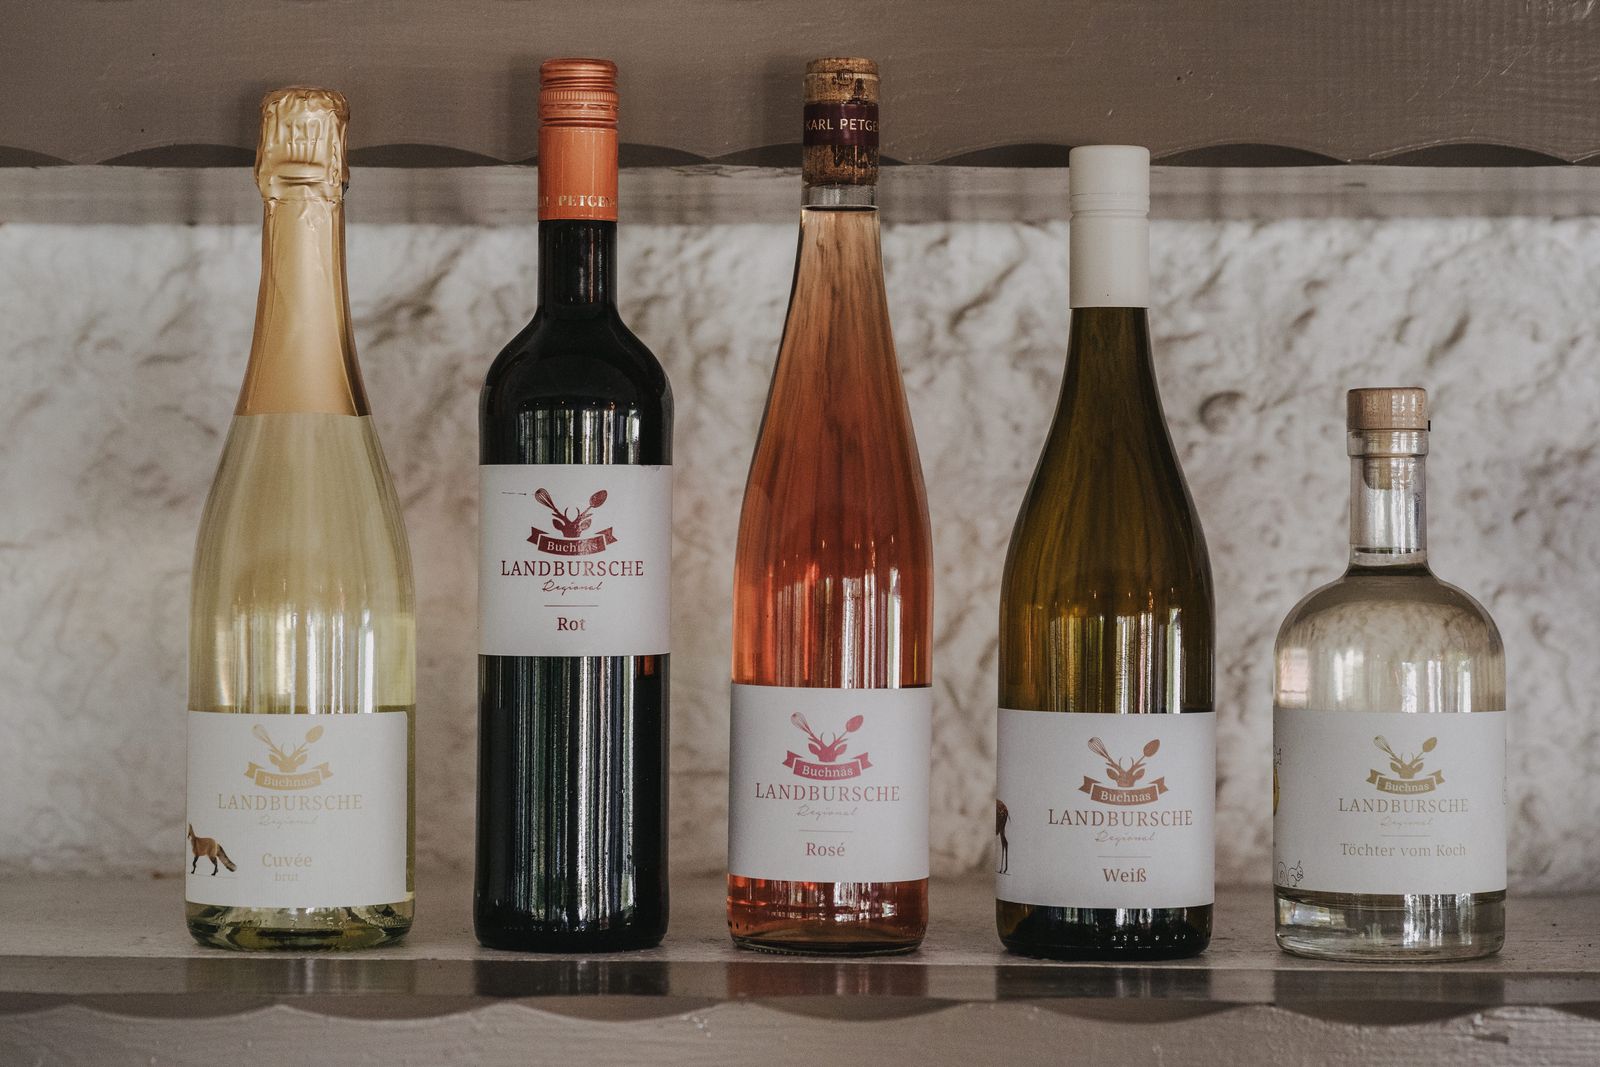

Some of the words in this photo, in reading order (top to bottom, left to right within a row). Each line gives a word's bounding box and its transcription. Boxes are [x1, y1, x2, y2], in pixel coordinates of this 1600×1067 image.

[501, 560, 644, 577] LANDBURSCHE
[542, 579, 602, 595] Regional
[557, 617, 587, 631] Rot
[801, 765, 854, 778] Buchnas
[755, 782, 901, 802] LANDBURSCHE
[1384, 781, 1430, 793] Buchnas
[217, 793, 363, 811] LANDBURSCHE
[1100, 790, 1152, 803] Buchnas
[797, 805, 858, 820] Regional
[1337, 797, 1470, 814] LANDBURSCHE
[1048, 808, 1193, 827] LANDBURSCHE
[1095, 831, 1155, 846] Regional
[806, 842, 846, 857] Rosé
[1340, 843, 1396, 857] Töchter
[1400, 846, 1432, 857] vom
[1436, 844, 1467, 857] Koch
[262, 853, 313, 868] Cuvée
[1102, 867, 1147, 883] Weiß
